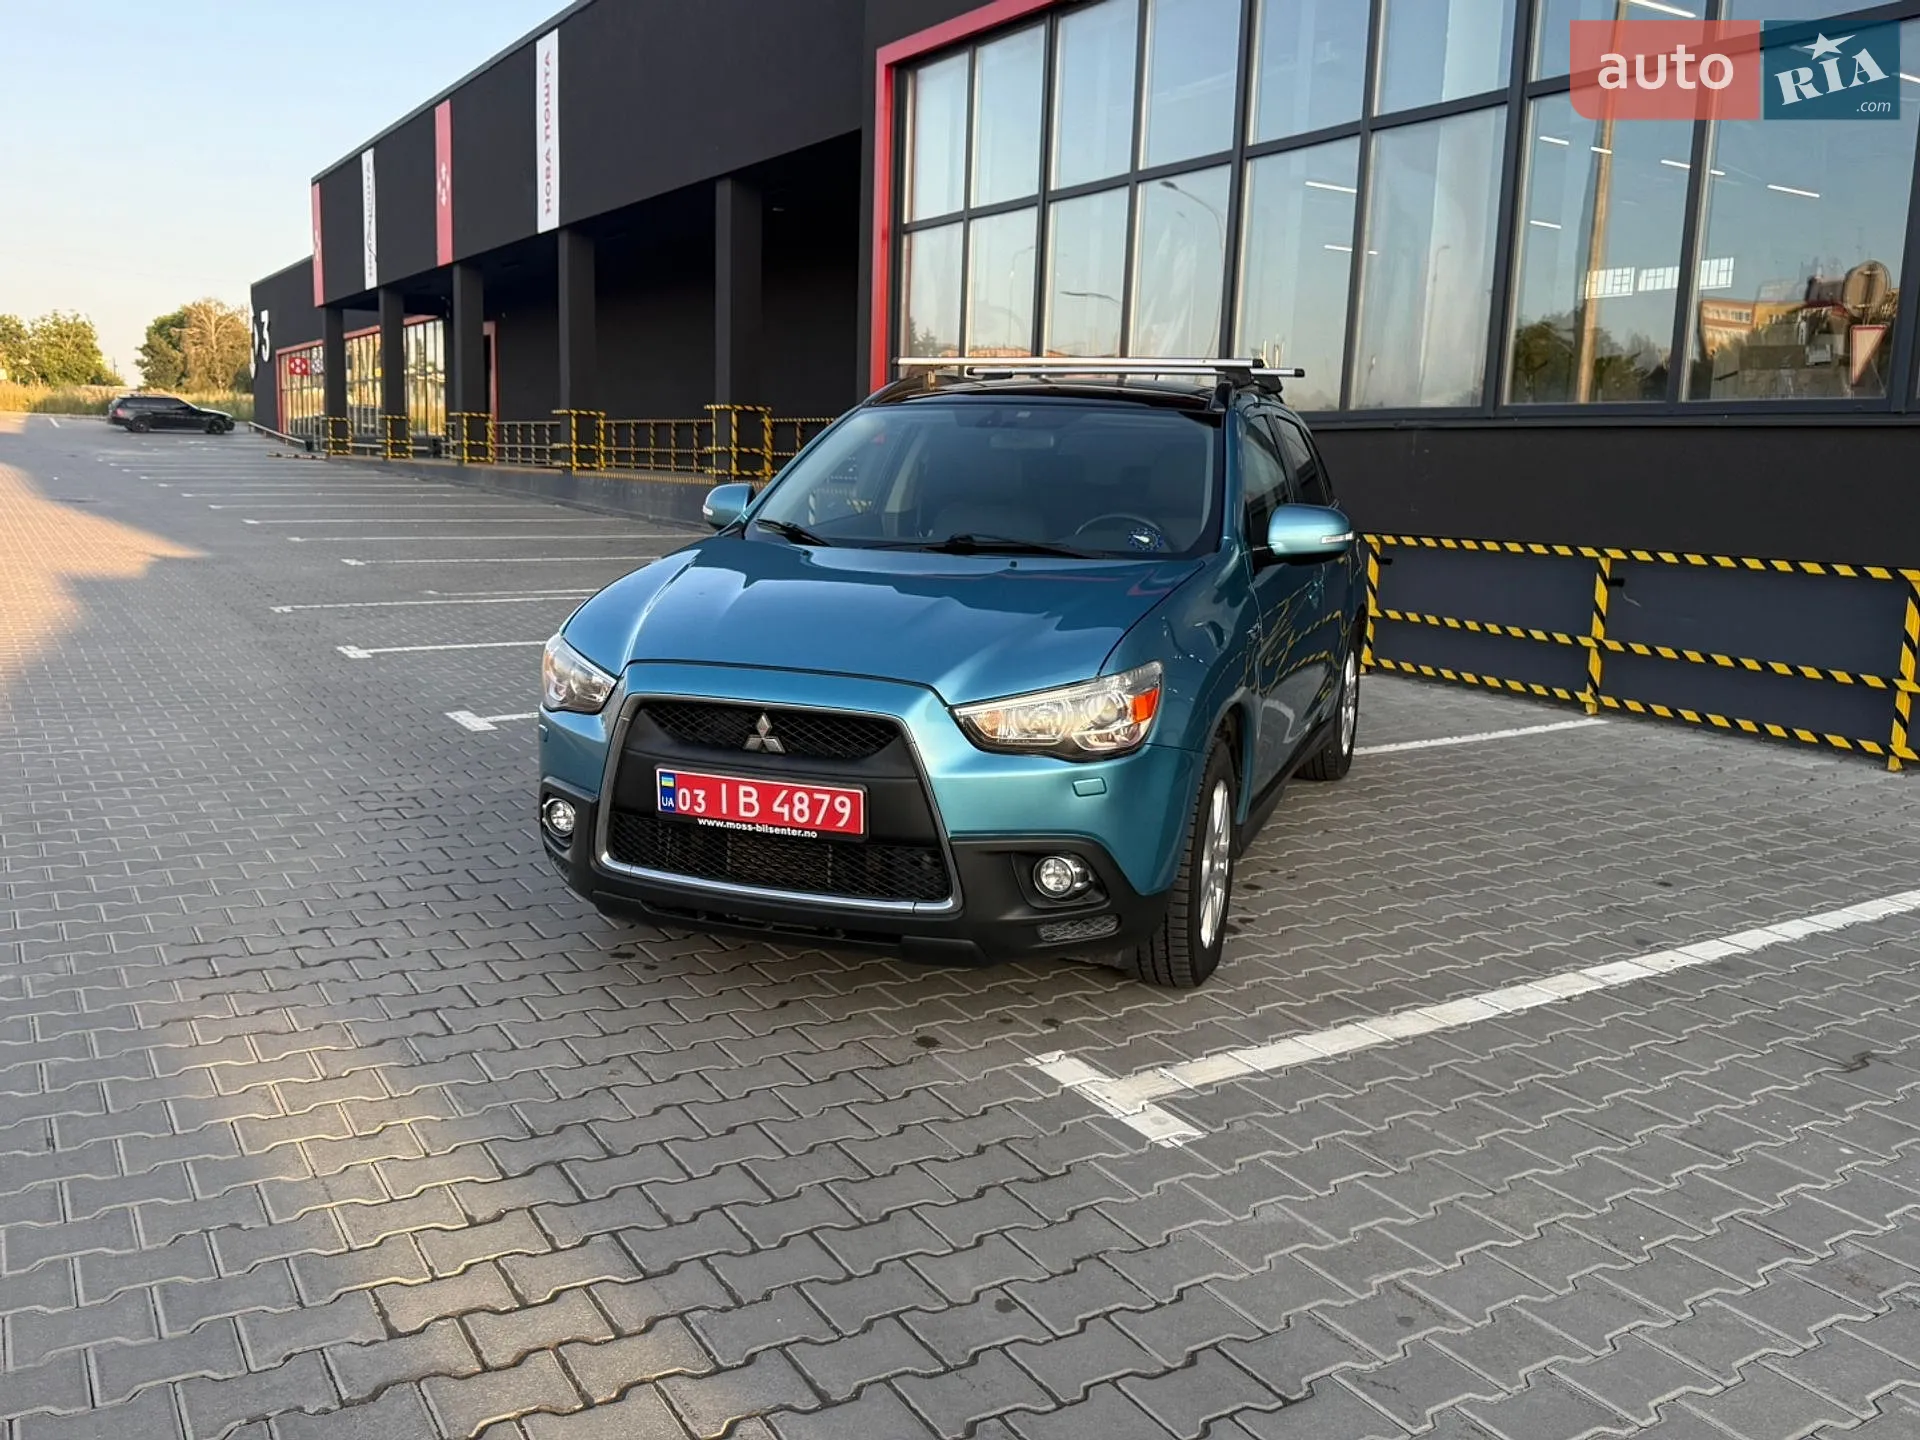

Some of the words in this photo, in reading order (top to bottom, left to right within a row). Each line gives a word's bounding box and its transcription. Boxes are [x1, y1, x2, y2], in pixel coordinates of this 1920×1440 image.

[543, 50, 552, 143] ПОШТА
[544, 146, 552, 217] НОВА
[661, 796, 675, 808] UA
[678, 788, 706, 813] 03
[772, 789, 851, 828] 4879
[697, 817, 818, 839] www.moss-bilsenter.no
